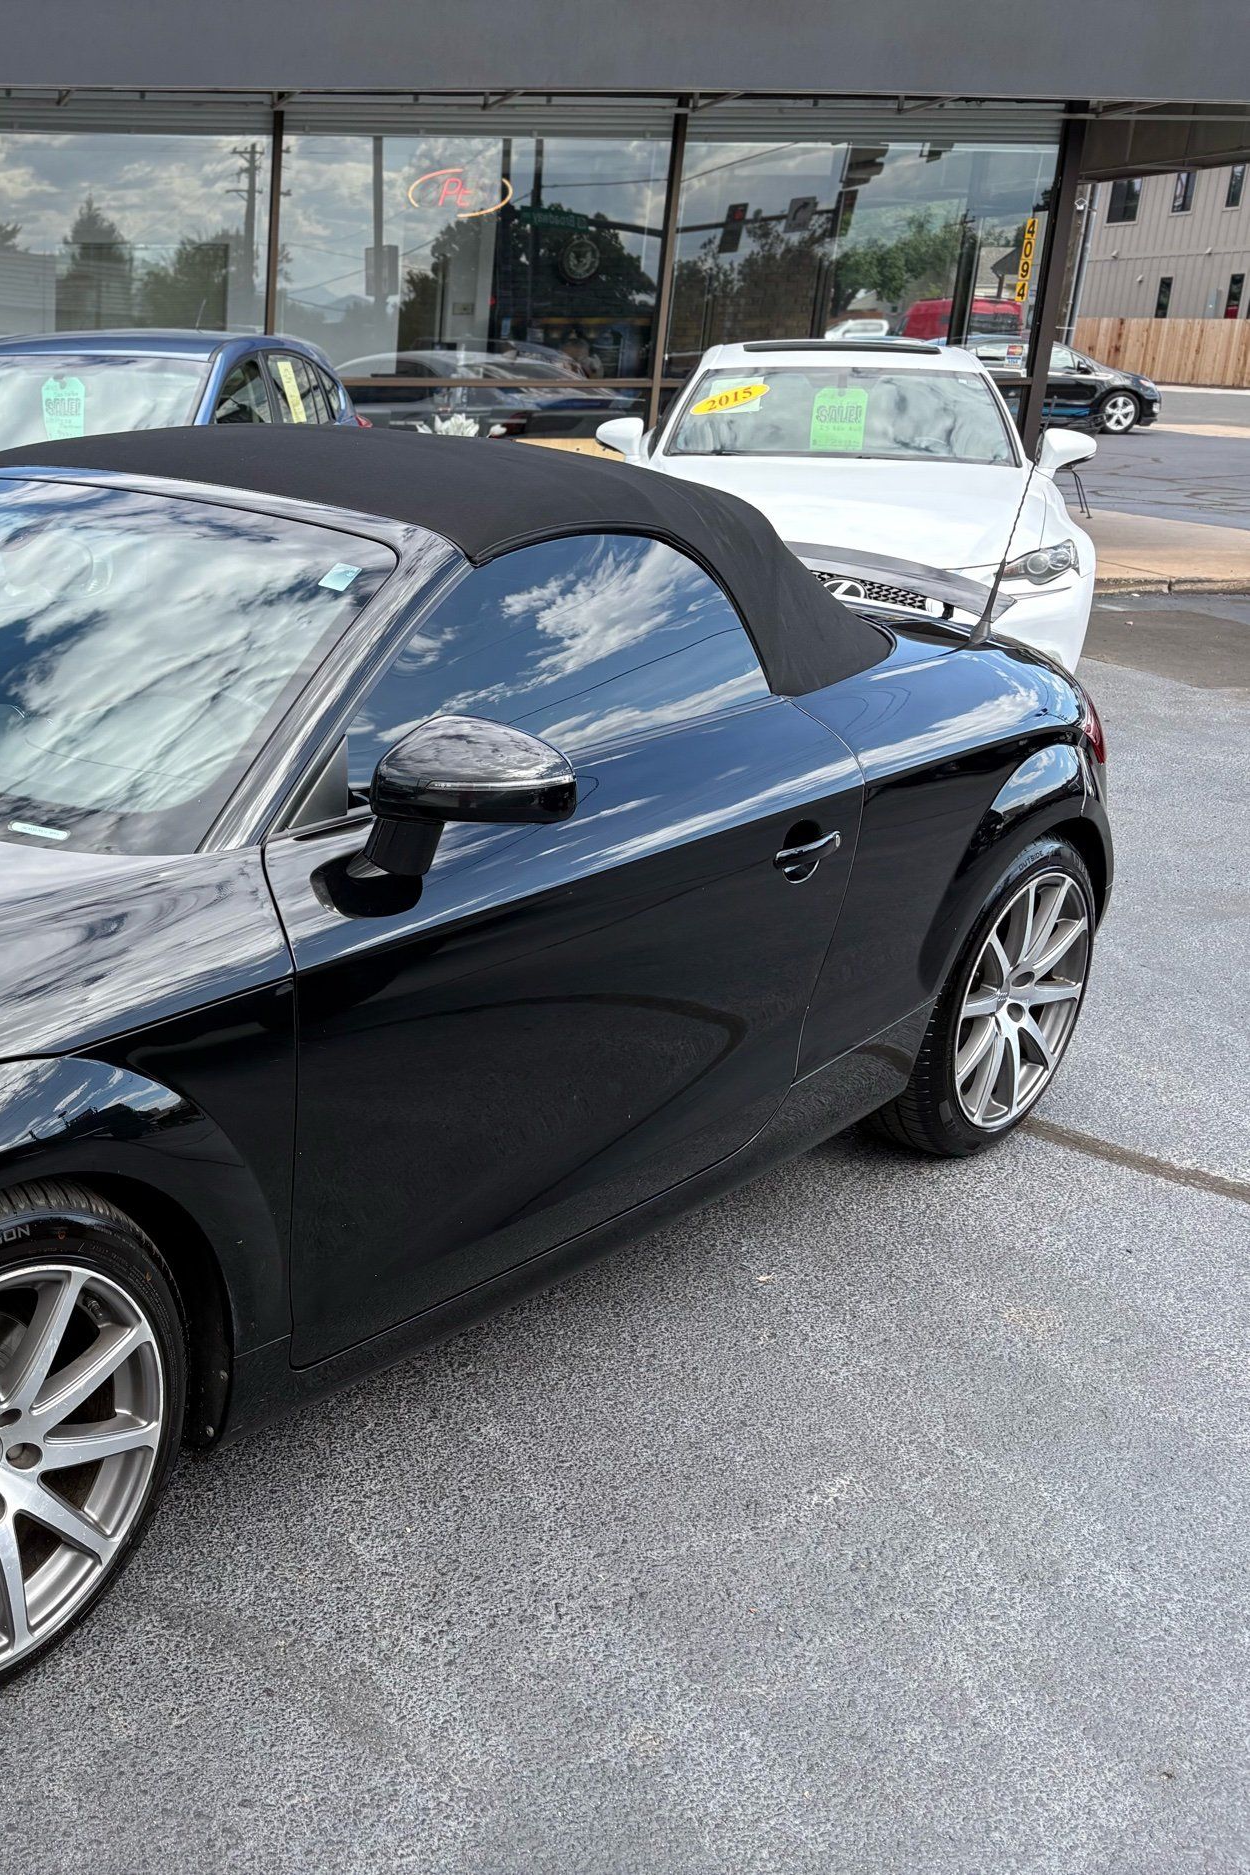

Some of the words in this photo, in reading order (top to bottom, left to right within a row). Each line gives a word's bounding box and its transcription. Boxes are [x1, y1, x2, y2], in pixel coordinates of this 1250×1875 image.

[1017, 219, 1036, 300] 4094
[706, 386, 753, 412] 2015
[815, 405, 863, 424] SALE!
[1018, 850, 1045, 872] OUTSIDE
